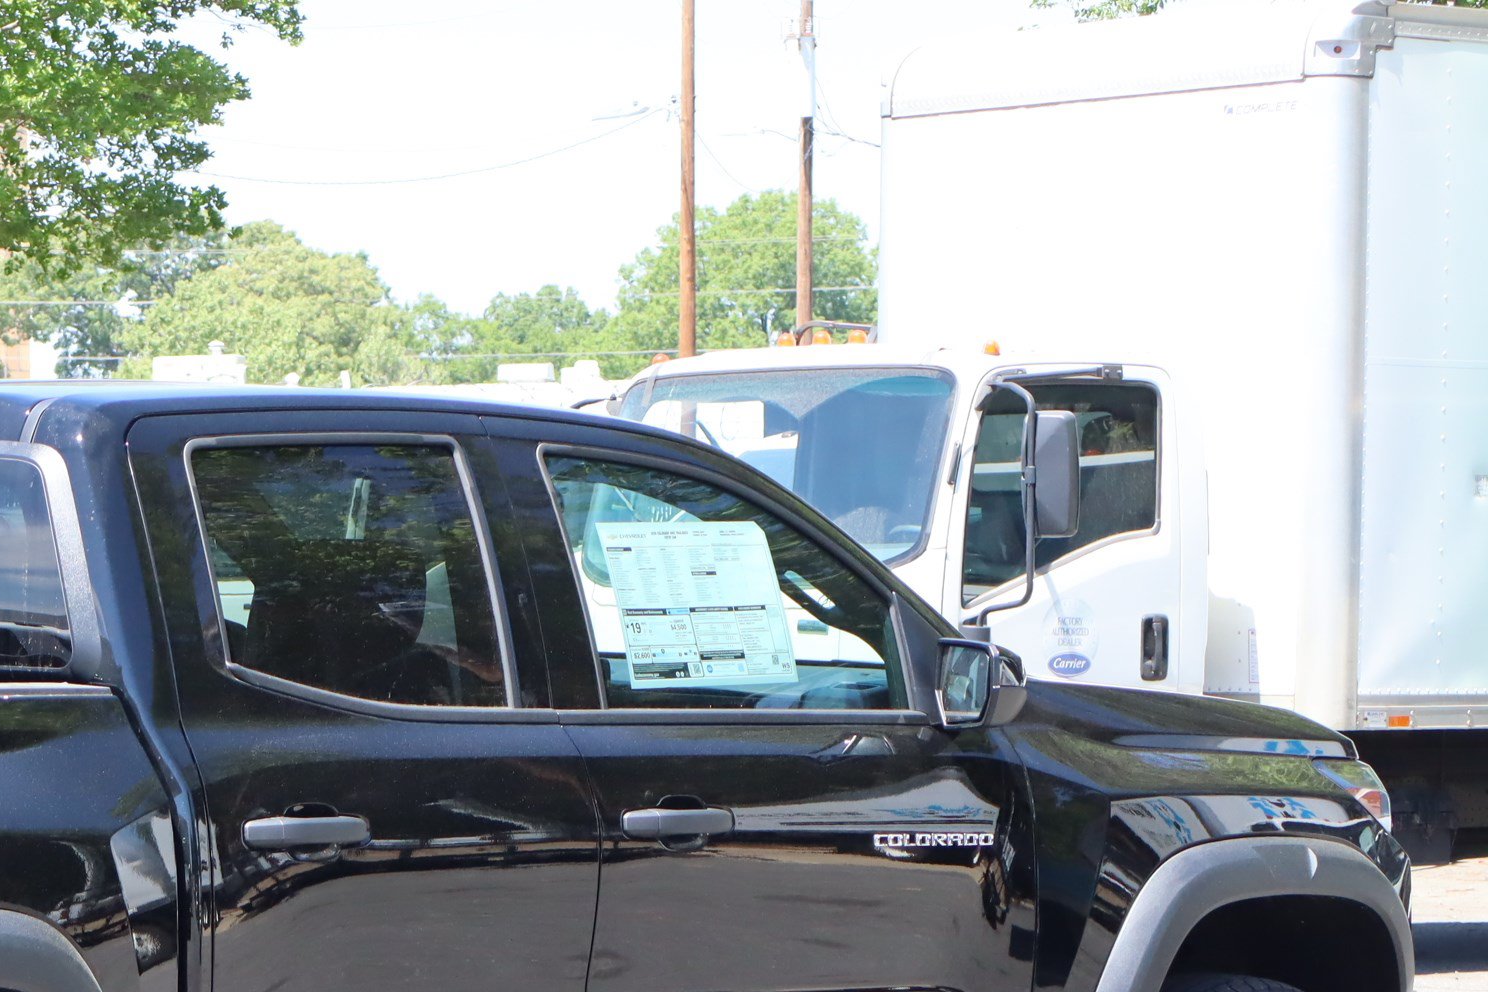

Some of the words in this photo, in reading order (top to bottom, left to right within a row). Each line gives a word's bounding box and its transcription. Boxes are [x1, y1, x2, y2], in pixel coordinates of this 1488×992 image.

[1236, 101, 1299, 115] COMPLETE
[1057, 616, 1084, 626] FACTORY
[630, 622, 642, 634] 19
[1053, 627, 1090, 636] AUTHORIZED
[1057, 638, 1083, 646] DEALER
[1053, 657, 1087, 669] Carrier
[873, 833, 995, 847] COLORADO
